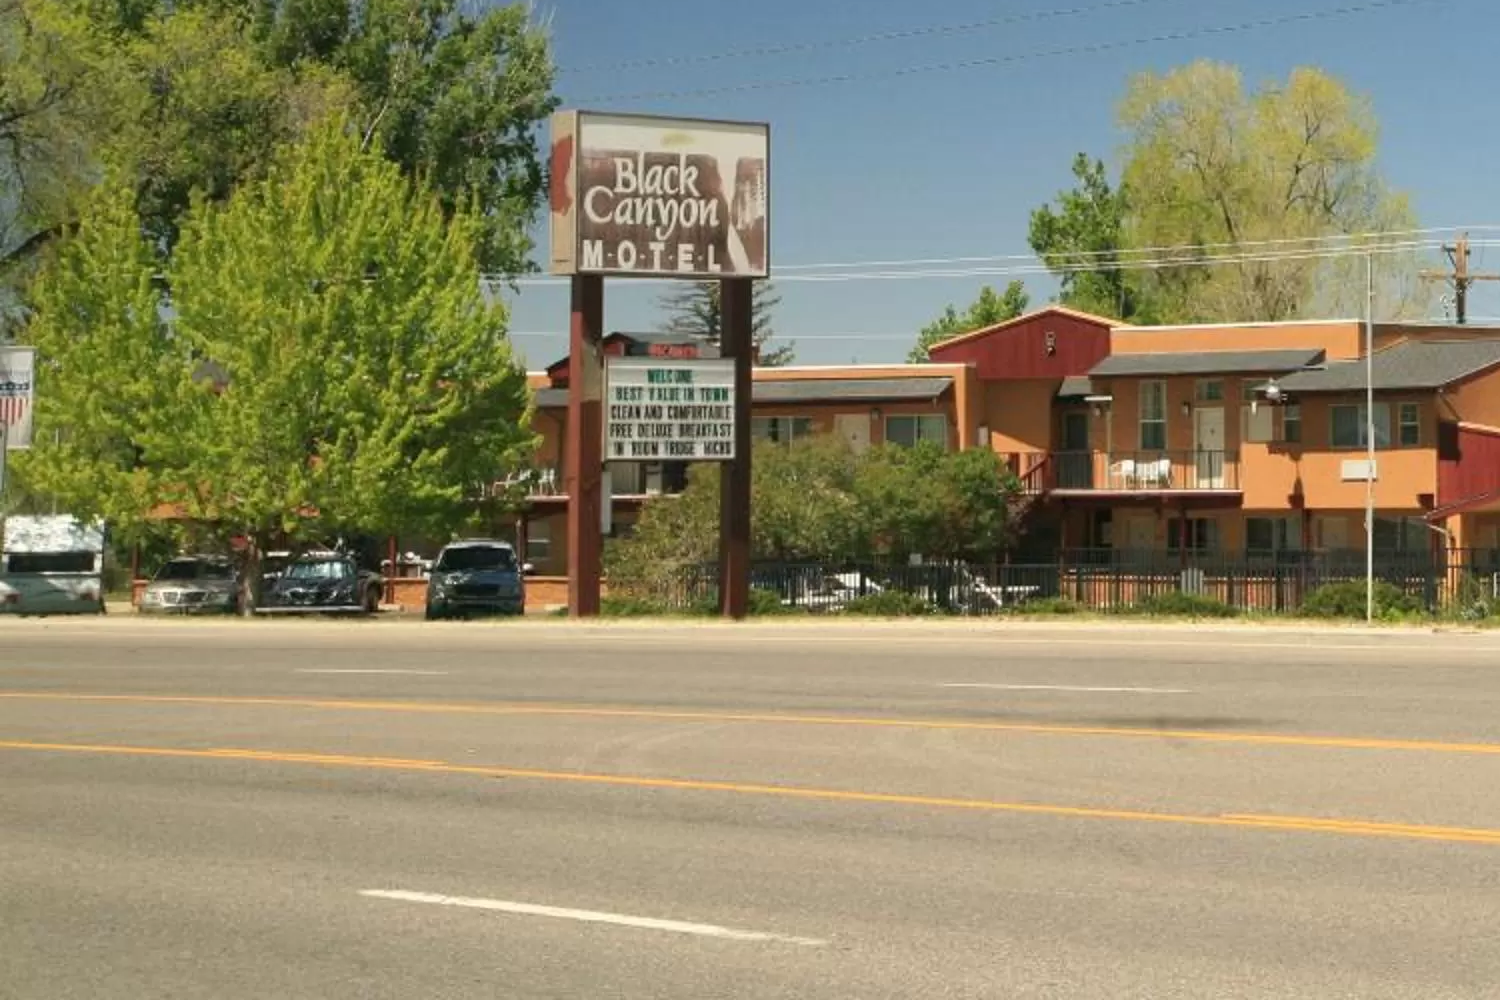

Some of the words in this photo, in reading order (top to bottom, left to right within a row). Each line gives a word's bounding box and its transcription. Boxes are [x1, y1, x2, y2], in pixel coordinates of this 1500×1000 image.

[613, 151, 700, 197] Black
[583, 185, 719, 241] Canyon
[615, 386, 643, 401] BEST
[648, 386, 680, 401] VALUE
[684, 386, 695, 401] IN
[700, 386, 729, 401] TOWN
[610, 404, 641, 420] CLEAN
[643, 404, 663, 420] AND
[667, 404, 732, 420] COMFORTABLE
[609, 423, 633, 438] FREE
[637, 423, 673, 438] DELUXE
[679, 423, 732, 438] BREAKFAST
[613, 441, 625, 456] IN
[632, 441, 659, 456] ROOM
